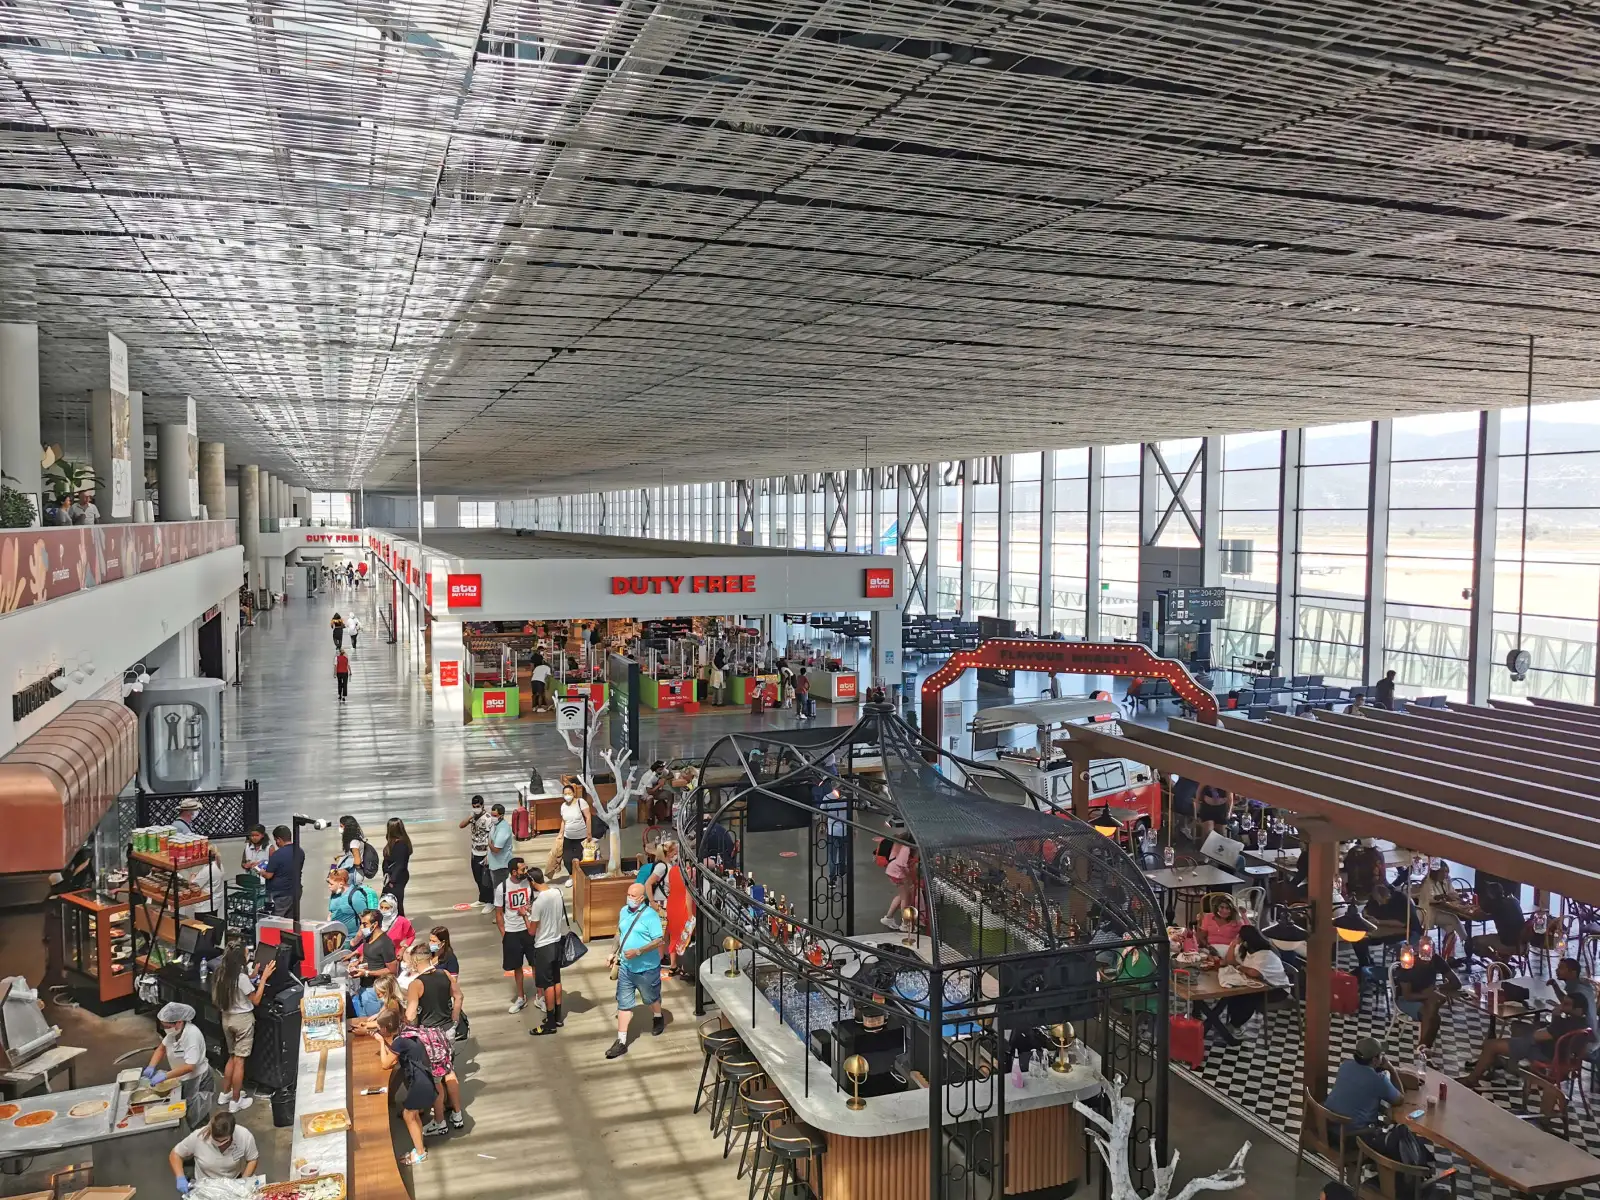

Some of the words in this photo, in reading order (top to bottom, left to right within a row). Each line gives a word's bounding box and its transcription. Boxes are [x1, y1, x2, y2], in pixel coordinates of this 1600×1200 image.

[306, 534, 332, 543] DUTY
[336, 534, 359, 543] FREE
[610, 575, 684, 595] DUTY
[691, 575, 756, 593] FREE
